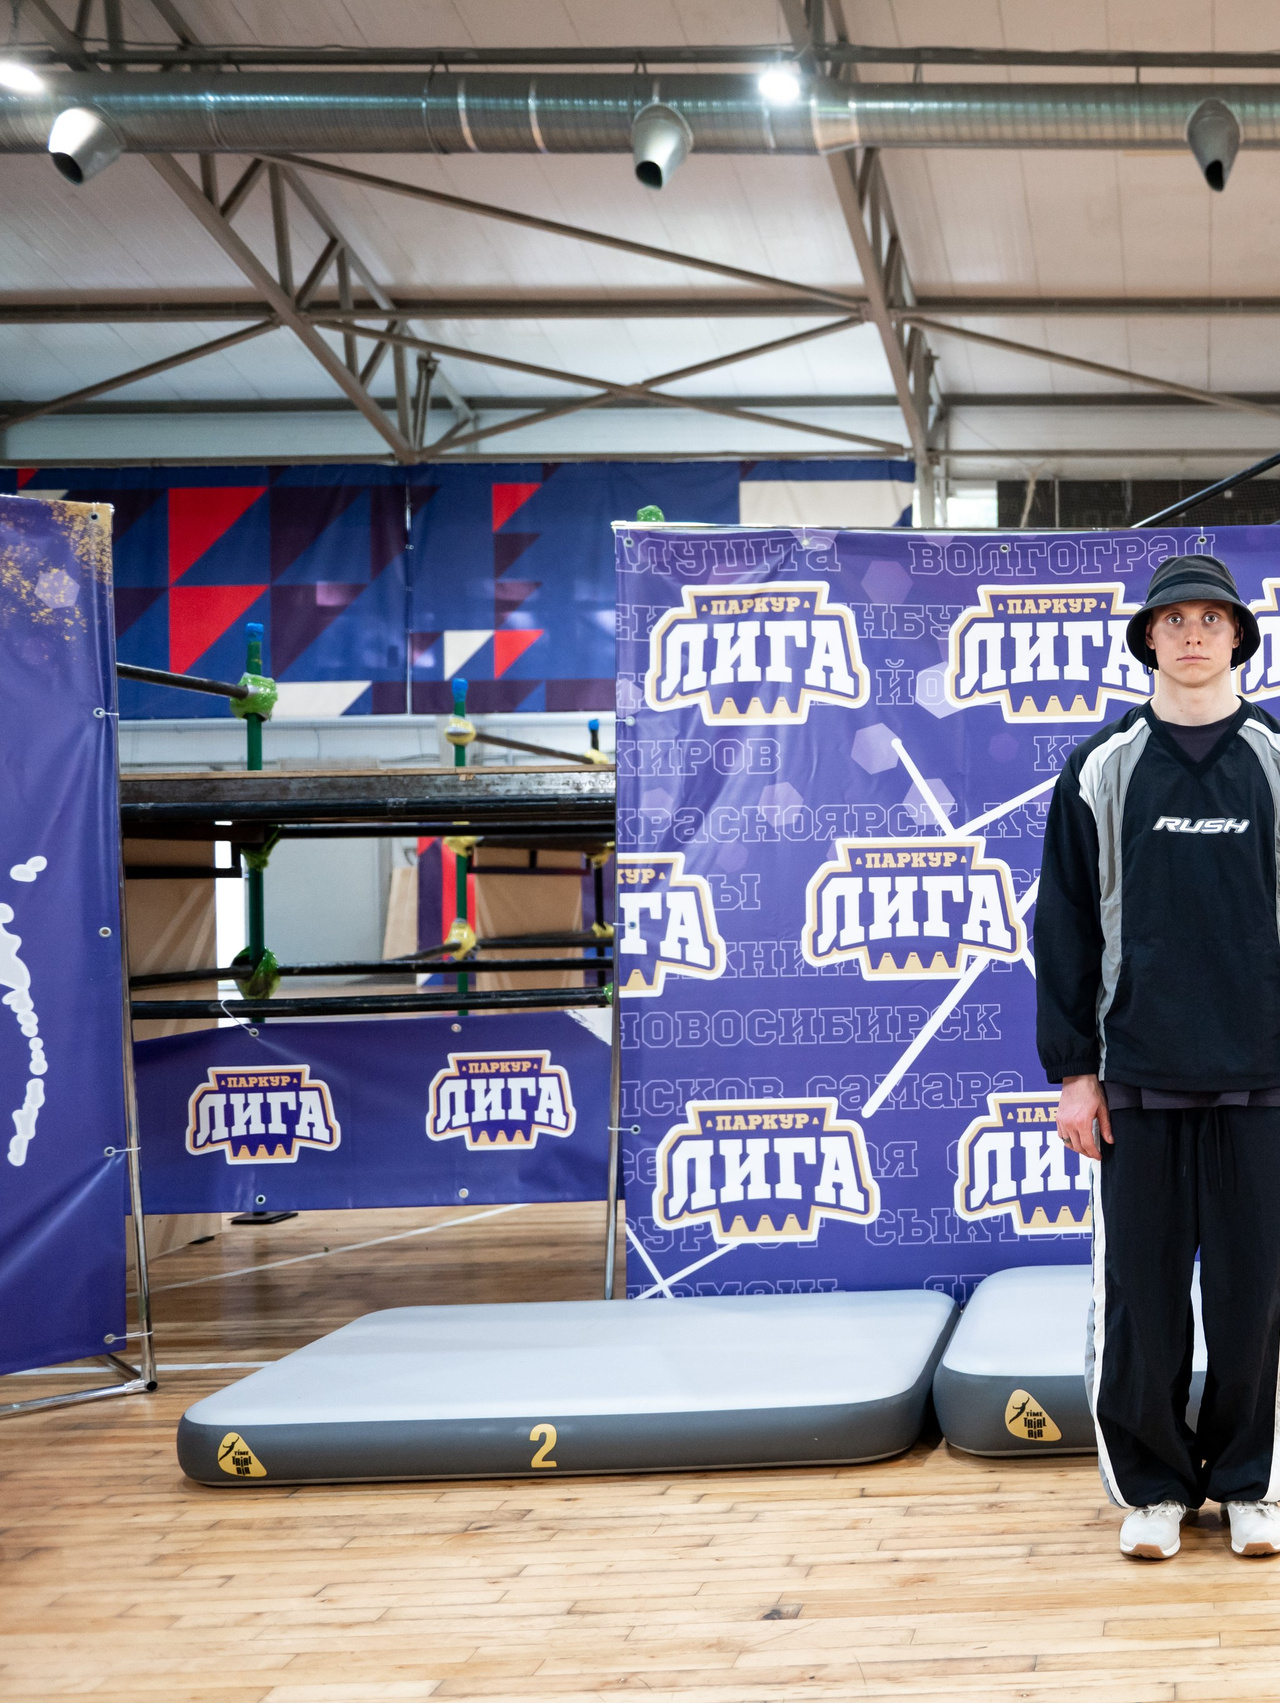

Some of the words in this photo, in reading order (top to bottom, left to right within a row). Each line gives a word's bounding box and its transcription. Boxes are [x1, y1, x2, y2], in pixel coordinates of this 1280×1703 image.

[710, 596, 801, 615] ПАРКУР
[1007, 597, 1098, 615] ПАРКУР
[661, 620, 855, 699] ЛИГА
[960, 619, 1151, 697] ЛИГА
[1152, 815, 1250, 834] RUSH
[864, 852, 958, 869] ПАРКУР
[818, 874, 1012, 955] ЛИГА
[226, 1075, 289, 1089] ПАРКУР
[467, 1060, 532, 1075] ПАРКУР
[196, 1090, 330, 1147] ЛИГА
[437, 1076, 567, 1132] ЛИГА
[716, 1113, 810, 1131] ПАРКУР
[669, 1135, 865, 1218] ЛИГА
[529, 1423, 558, 1469] 2
